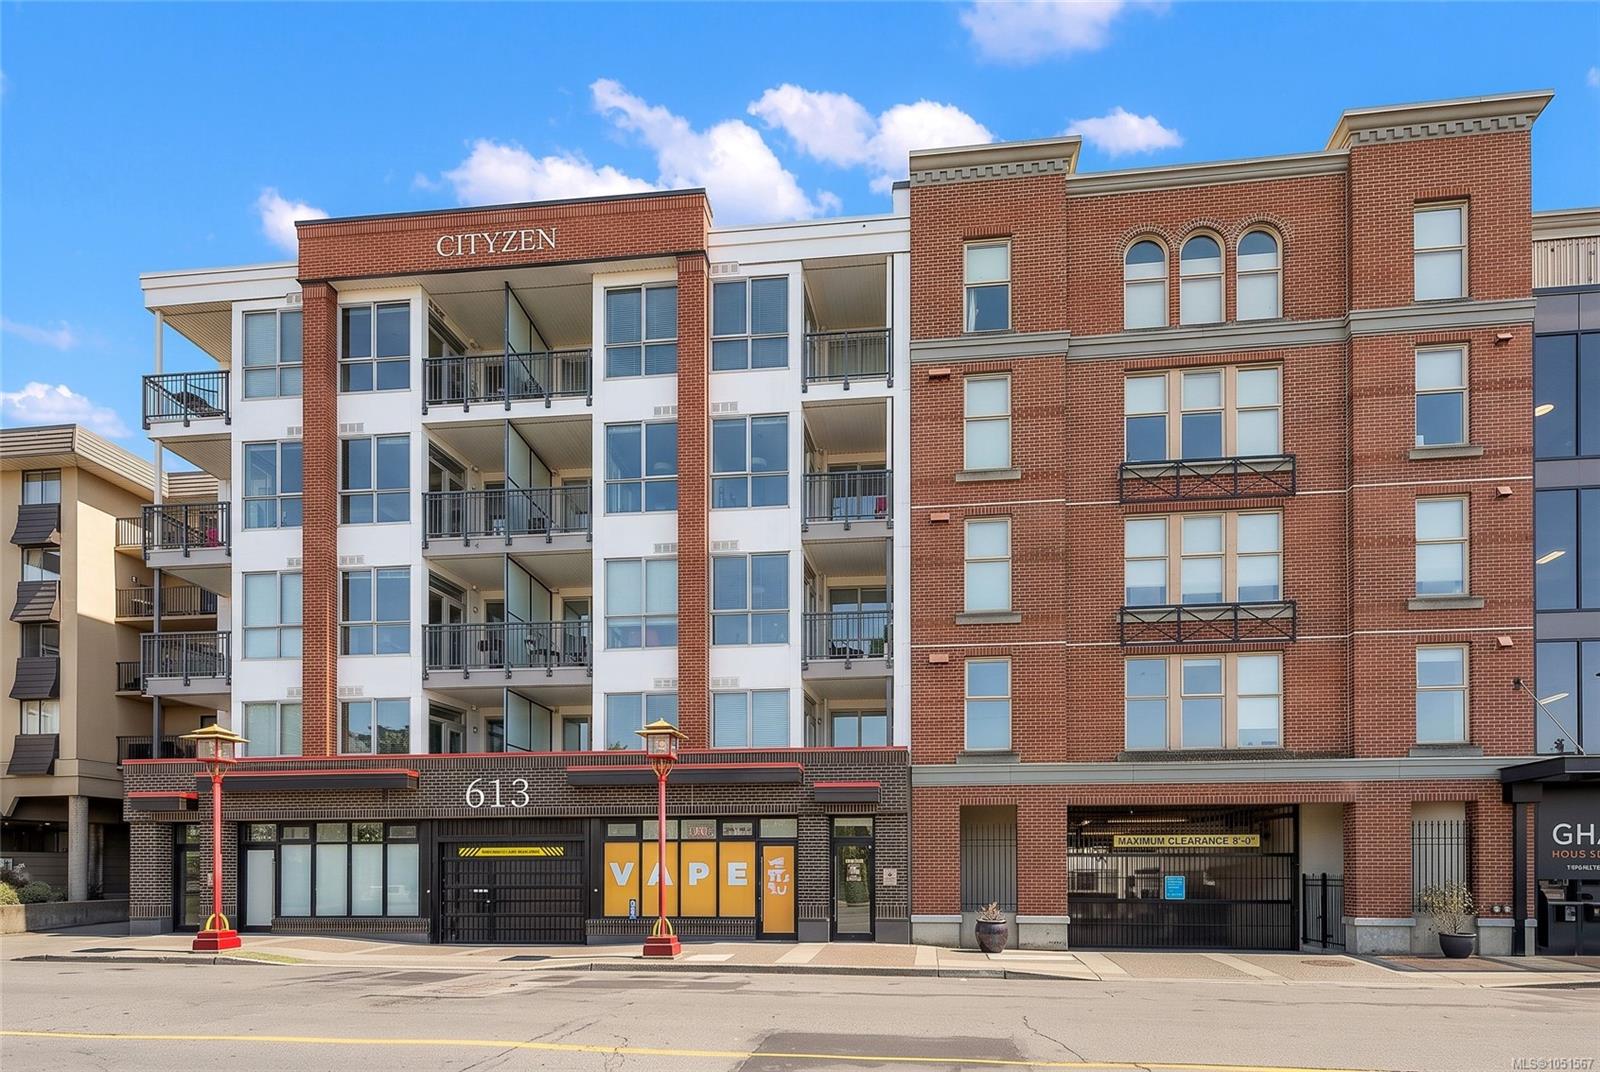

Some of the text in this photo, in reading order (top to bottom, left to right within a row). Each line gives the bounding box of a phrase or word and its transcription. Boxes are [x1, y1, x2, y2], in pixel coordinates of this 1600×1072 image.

[436, 227, 557, 257] CITYZEN
[465, 778, 530, 808] 613
[1118, 836, 1256, 846] MAXIMUM CLEARANCE 8'-0"
[1552, 823, 1600, 845] GH
[609, 861, 749, 886] VAPE
